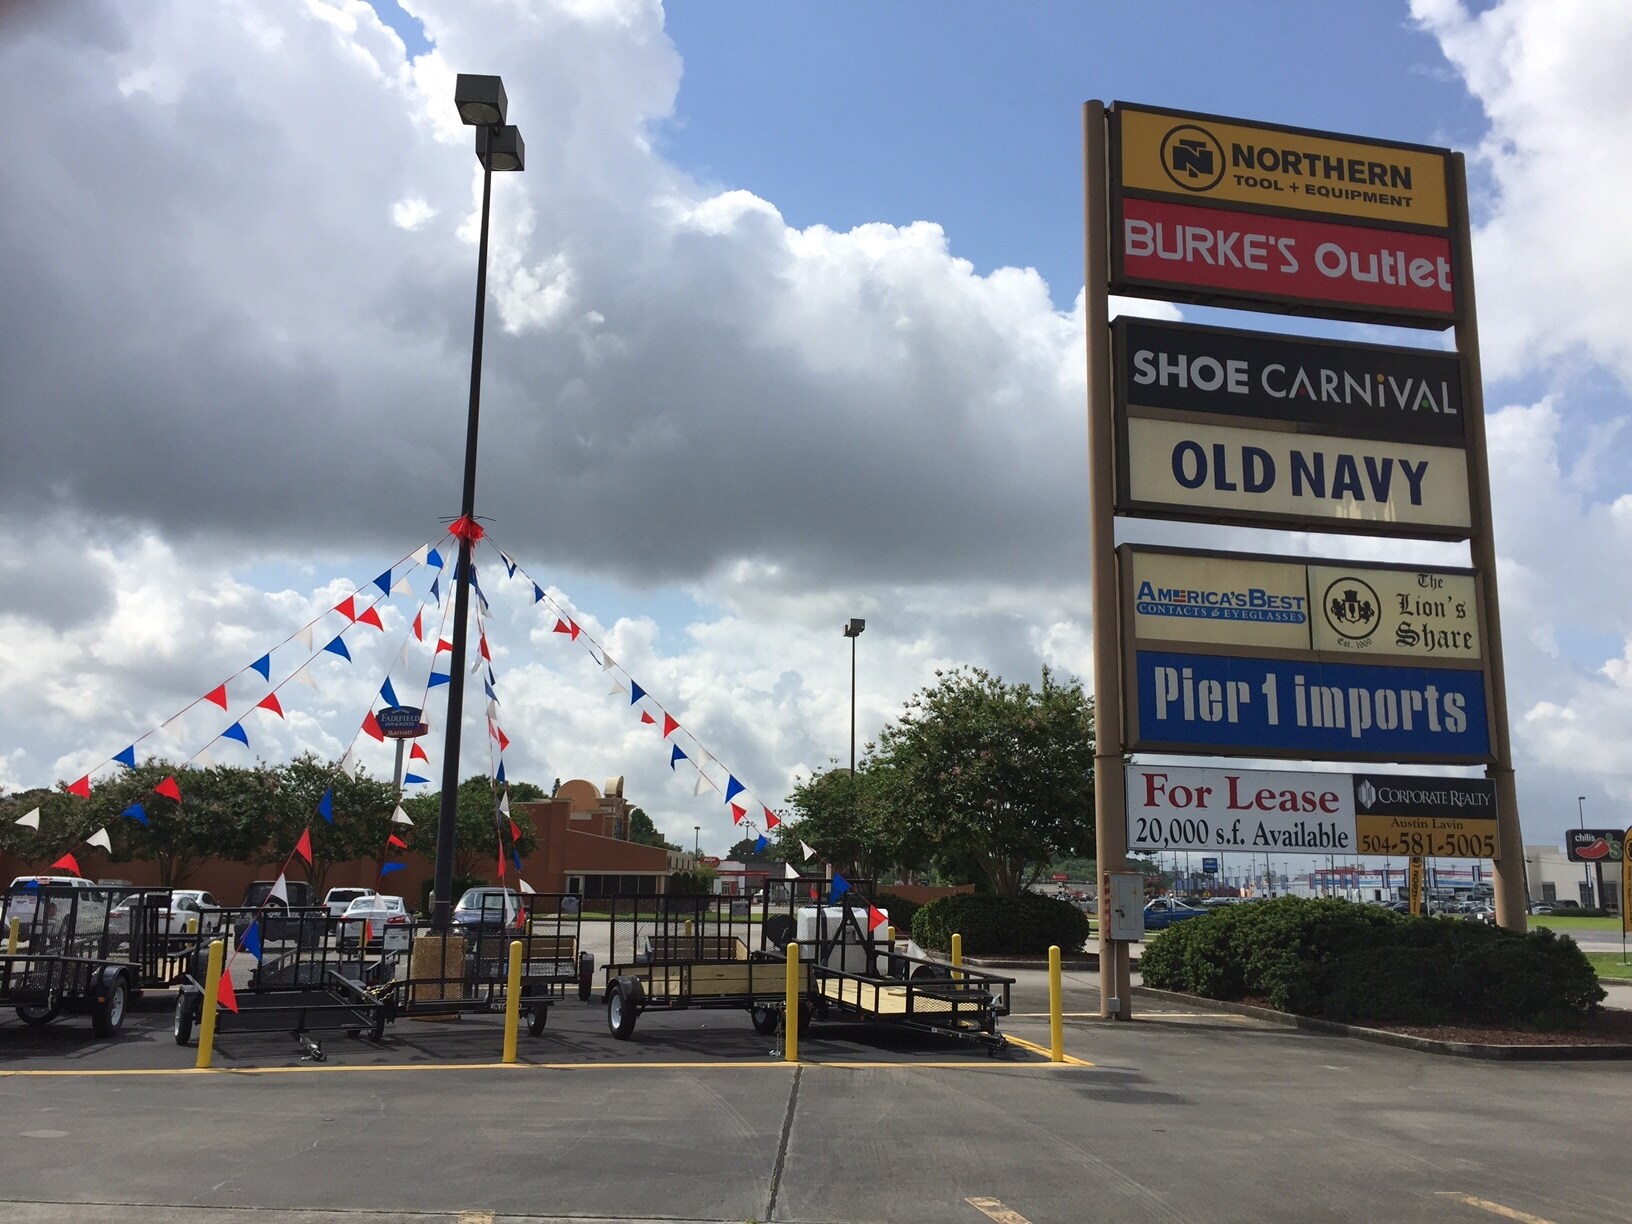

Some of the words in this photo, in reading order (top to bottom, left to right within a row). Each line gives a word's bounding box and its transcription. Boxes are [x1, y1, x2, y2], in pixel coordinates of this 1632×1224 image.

[1232, 143, 1412, 190] NORTHERN
[1233, 174, 1284, 191] TOOL
[1289, 182, 1299, 193] +
[1305, 183, 1413, 207] EQUIPMENT
[1124, 218, 1299, 273] BURKE'S
[1314, 242, 1452, 292] Outlet
[1133, 349, 1250, 394] SHOE
[1171, 440, 1276, 493] OLD
[1289, 450, 1429, 506] NAVY
[1417, 573, 1443, 591] The
[1139, 603, 1207, 617] CONTACTS
[1211, 608, 1220, 617] &
[1224, 610, 1304, 623] EYEGLASSES
[1248, 588, 1305, 610] BEST
[1396, 593, 1466, 619] Lion's
[1395, 621, 1473, 652] Share
[381, 713, 420, 722] FAIRFIELD
[1154, 666, 1250, 723] Pier
[1261, 673, 1279, 726] 1
[1294, 675, 1467, 738] imports
[1142, 773, 1212, 809] For
[1224, 776, 1340, 814] Lease
[1378, 787, 1449, 805] CORPORATE
[1450, 790, 1492, 807] REALTY
[1136, 817, 1209, 848] 20,000
[1216, 819, 1245, 846] s.f.
[1253, 820, 1349, 849] Available
[1391, 817, 1428, 829] Austin
[1432, 818, 1464, 830] Lavin
[1362, 832, 1495, 857] 504-581-5005
